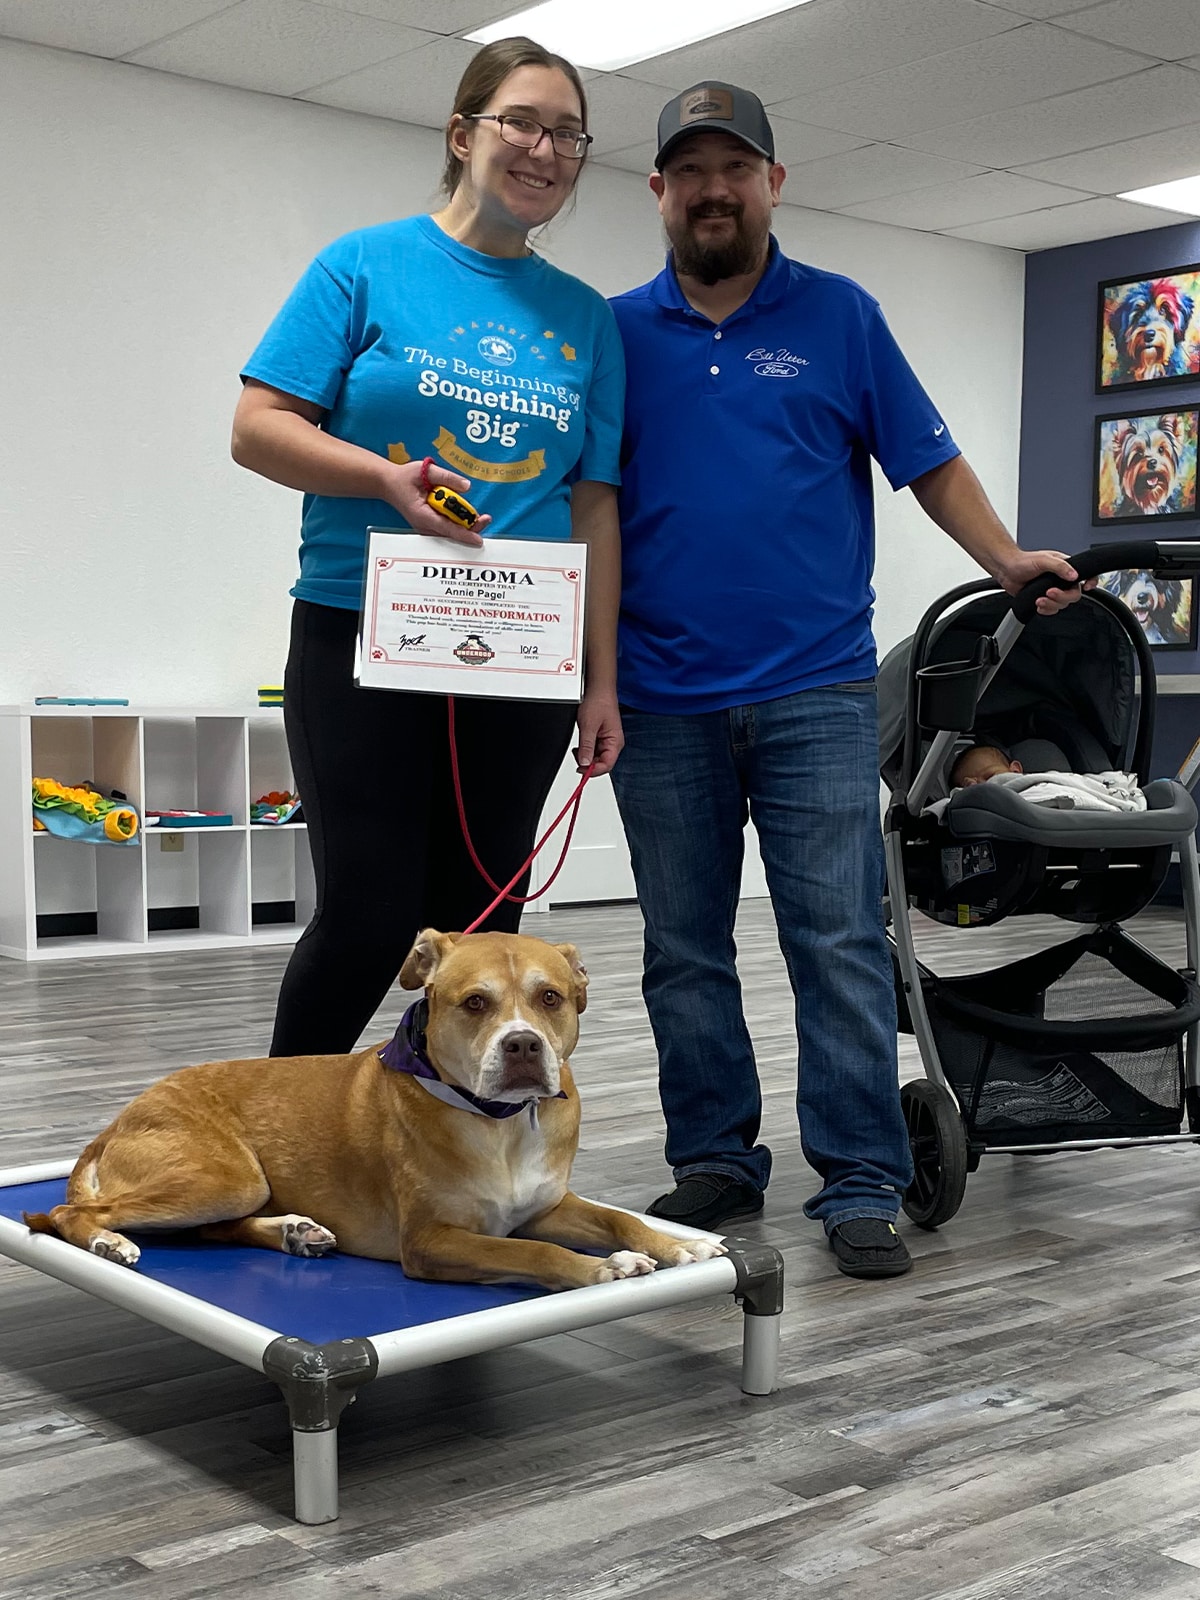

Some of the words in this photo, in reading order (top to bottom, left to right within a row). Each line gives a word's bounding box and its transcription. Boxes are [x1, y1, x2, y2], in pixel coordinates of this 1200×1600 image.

[744, 348, 774, 361] Bill
[775, 348, 810, 366] Utter
[404, 346, 448, 370] The
[453, 357, 567, 404] Beginning
[568, 392, 581, 412] of
[762, 363, 790, 375] Ford
[417, 369, 572, 433] Something
[466, 409, 521, 448] Big
[448, 450, 490, 474] PRIMROSE
[494, 466, 531, 476] SCHOOLS
[422, 566, 535, 585] DIPLOMA
[445, 587, 474, 597] Annie
[477, 589, 506, 601] Pagel
[391, 602, 452, 615] BEHAVIOR
[454, 607, 561, 623] TRANSFORMATION
[520, 645, 539, 654] 10/2
